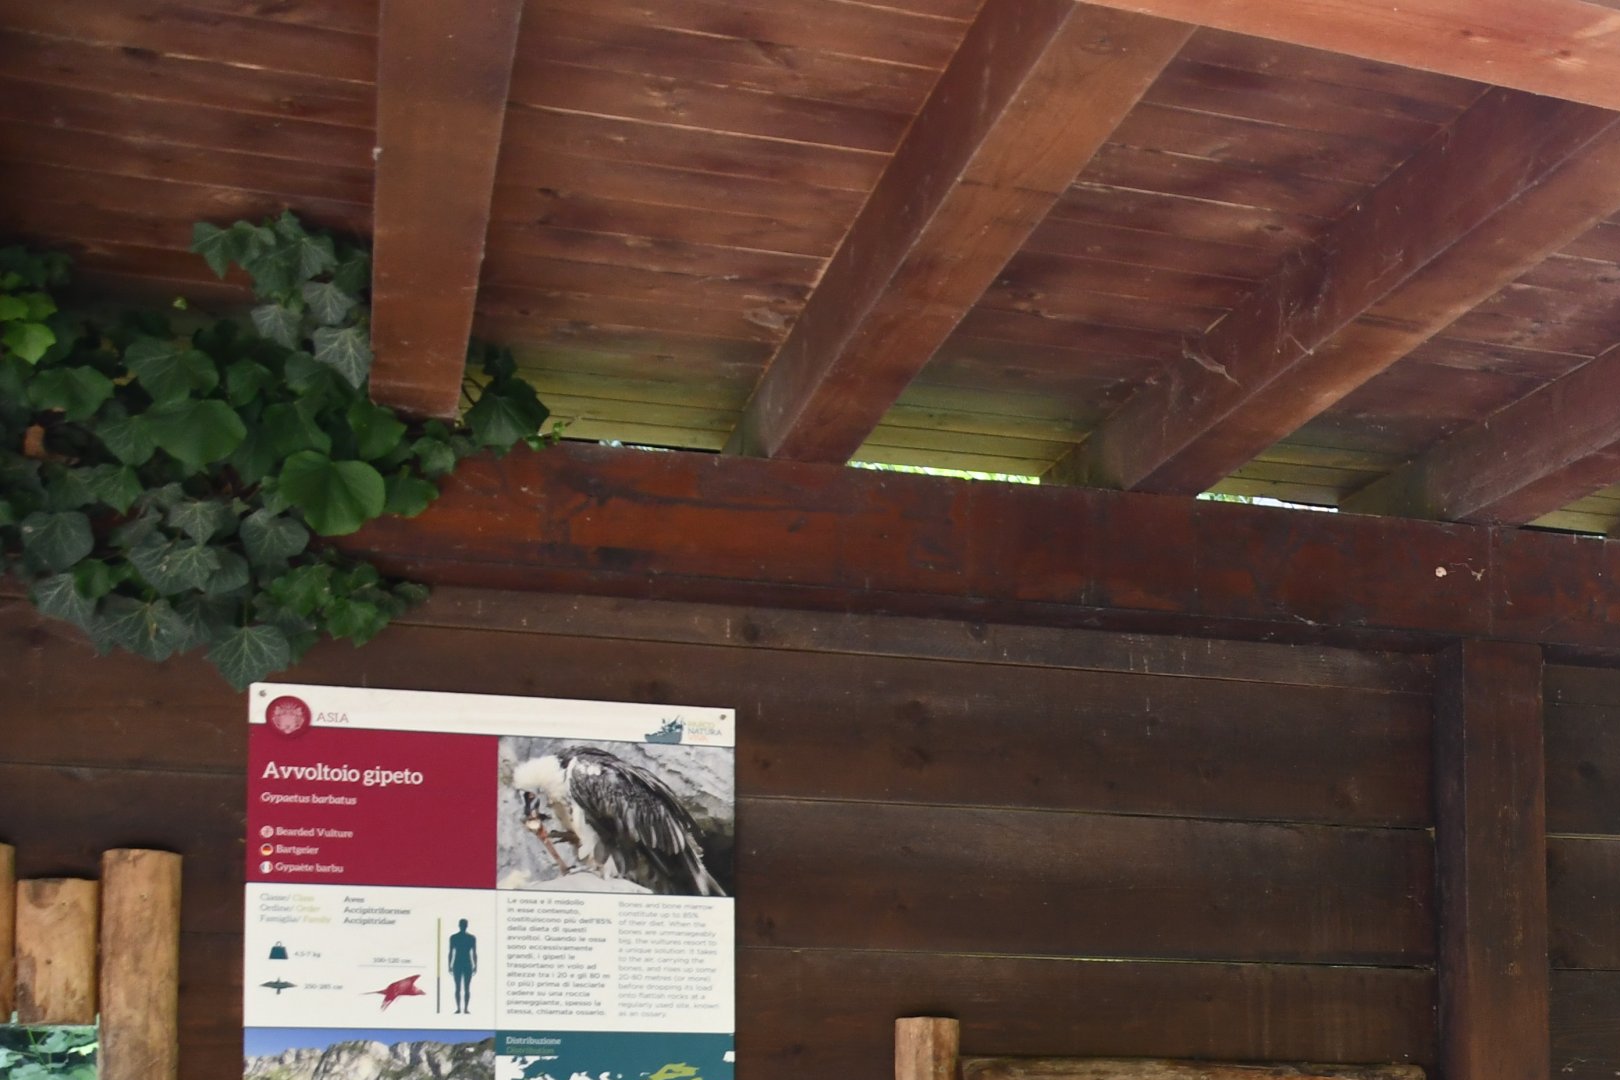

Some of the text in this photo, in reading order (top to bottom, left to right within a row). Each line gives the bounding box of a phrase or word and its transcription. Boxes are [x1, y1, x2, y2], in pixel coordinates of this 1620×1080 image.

[316, 713, 349, 723] ASIA
[262, 761, 423, 787] Avvoltoio gipeto
[261, 792, 357, 805] Gypaetus barbatus
[275, 827, 353, 838] Bearded Vulture
[275, 845, 319, 856] Bartgeier
[316, 863, 343, 873] barbu
[344, 906, 411, 915] Accipitriformes
[344, 917, 396, 925] Accipitridae
[506, 1036, 561, 1046] Distribuzione
